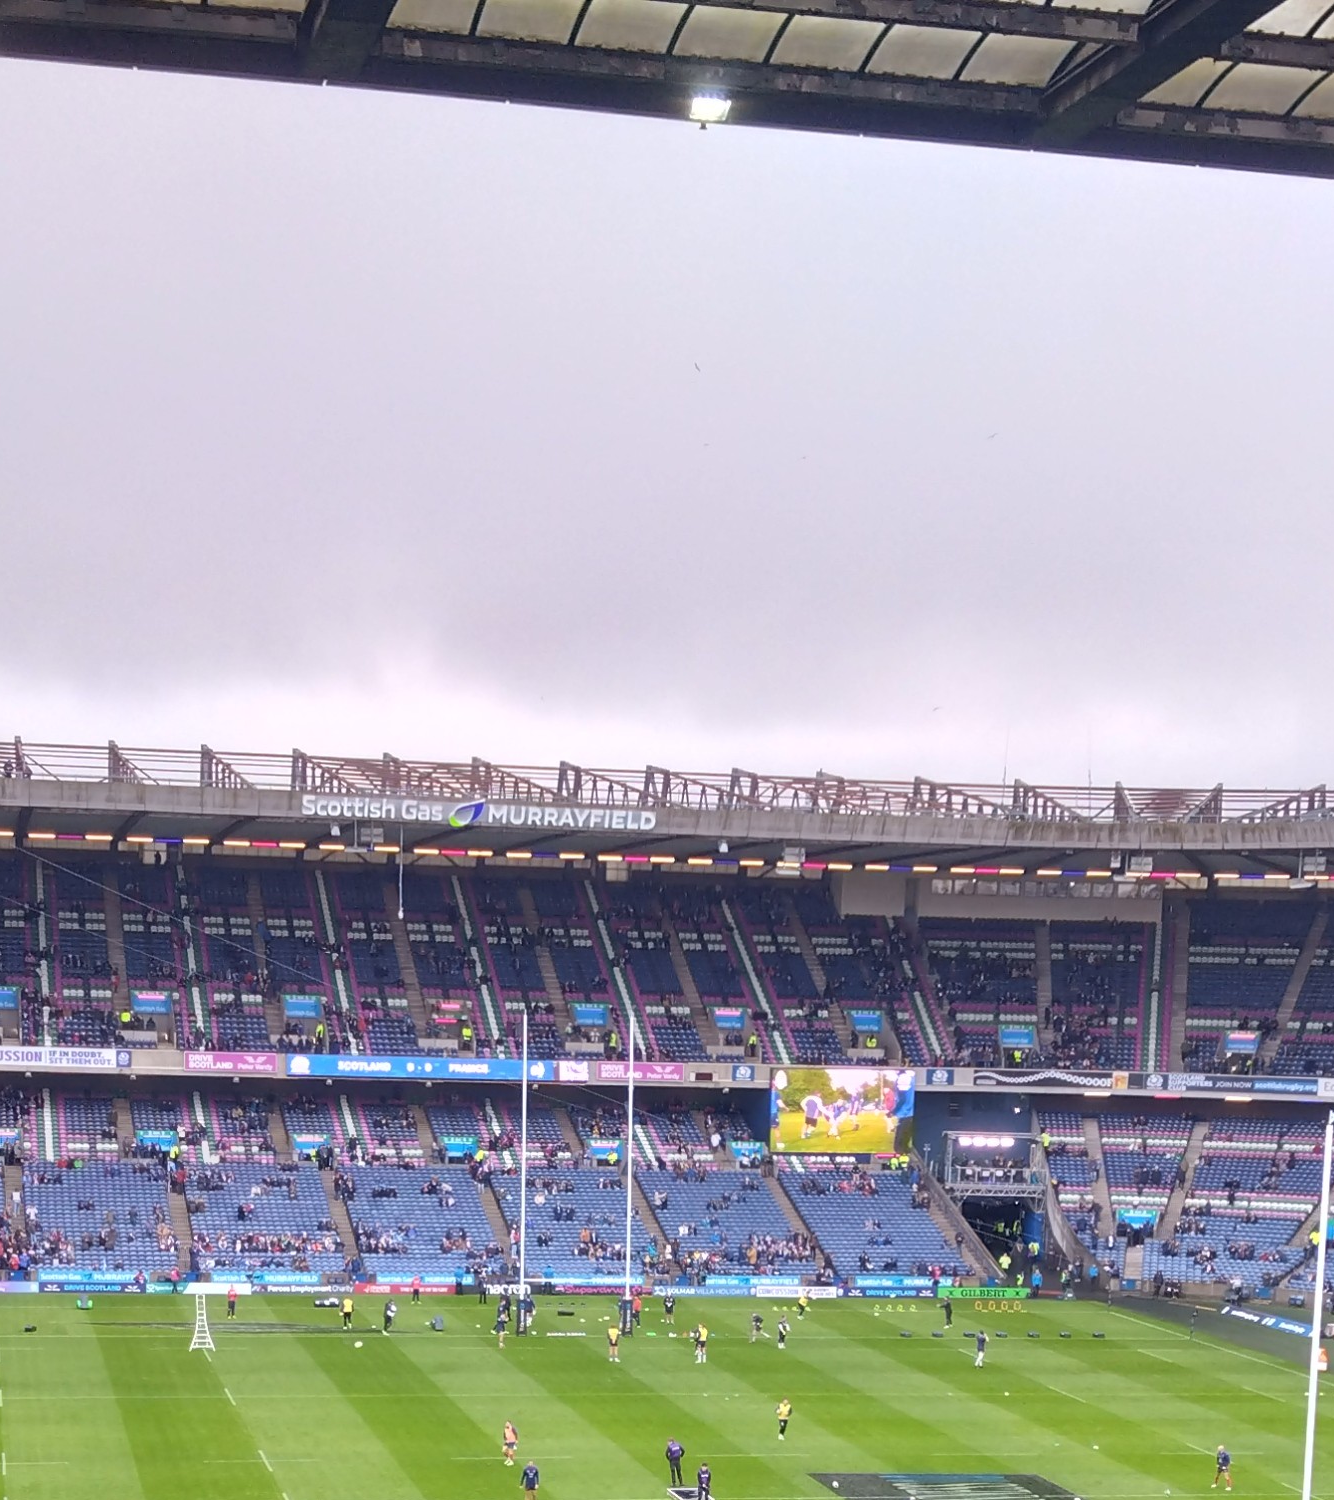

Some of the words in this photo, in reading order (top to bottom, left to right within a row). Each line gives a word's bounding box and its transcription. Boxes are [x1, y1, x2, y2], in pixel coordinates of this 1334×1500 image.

[301, 795, 396, 819] Scottish
[400, 800, 444, 822] Gas
[487, 804, 657, 830] MURRAYFIELD
[59, 1050, 69, 1058] IN
[189, 1054, 213, 1062] DRIVE
[49, 1056, 63, 1065] SIT
[66, 1057, 93, 1065] THEM
[337, 1061, 392, 1072] SCOTLAND
[448, 1064, 488, 1074] FRANCE
[601, 1064, 624, 1072] DRIVE
[1215, 1081, 1233, 1089] JOIN
[291, 1285, 331, 1293] Employment
[331, 1285, 354, 1293] Charity
[961, 1289, 1007, 1297] GILBERT
